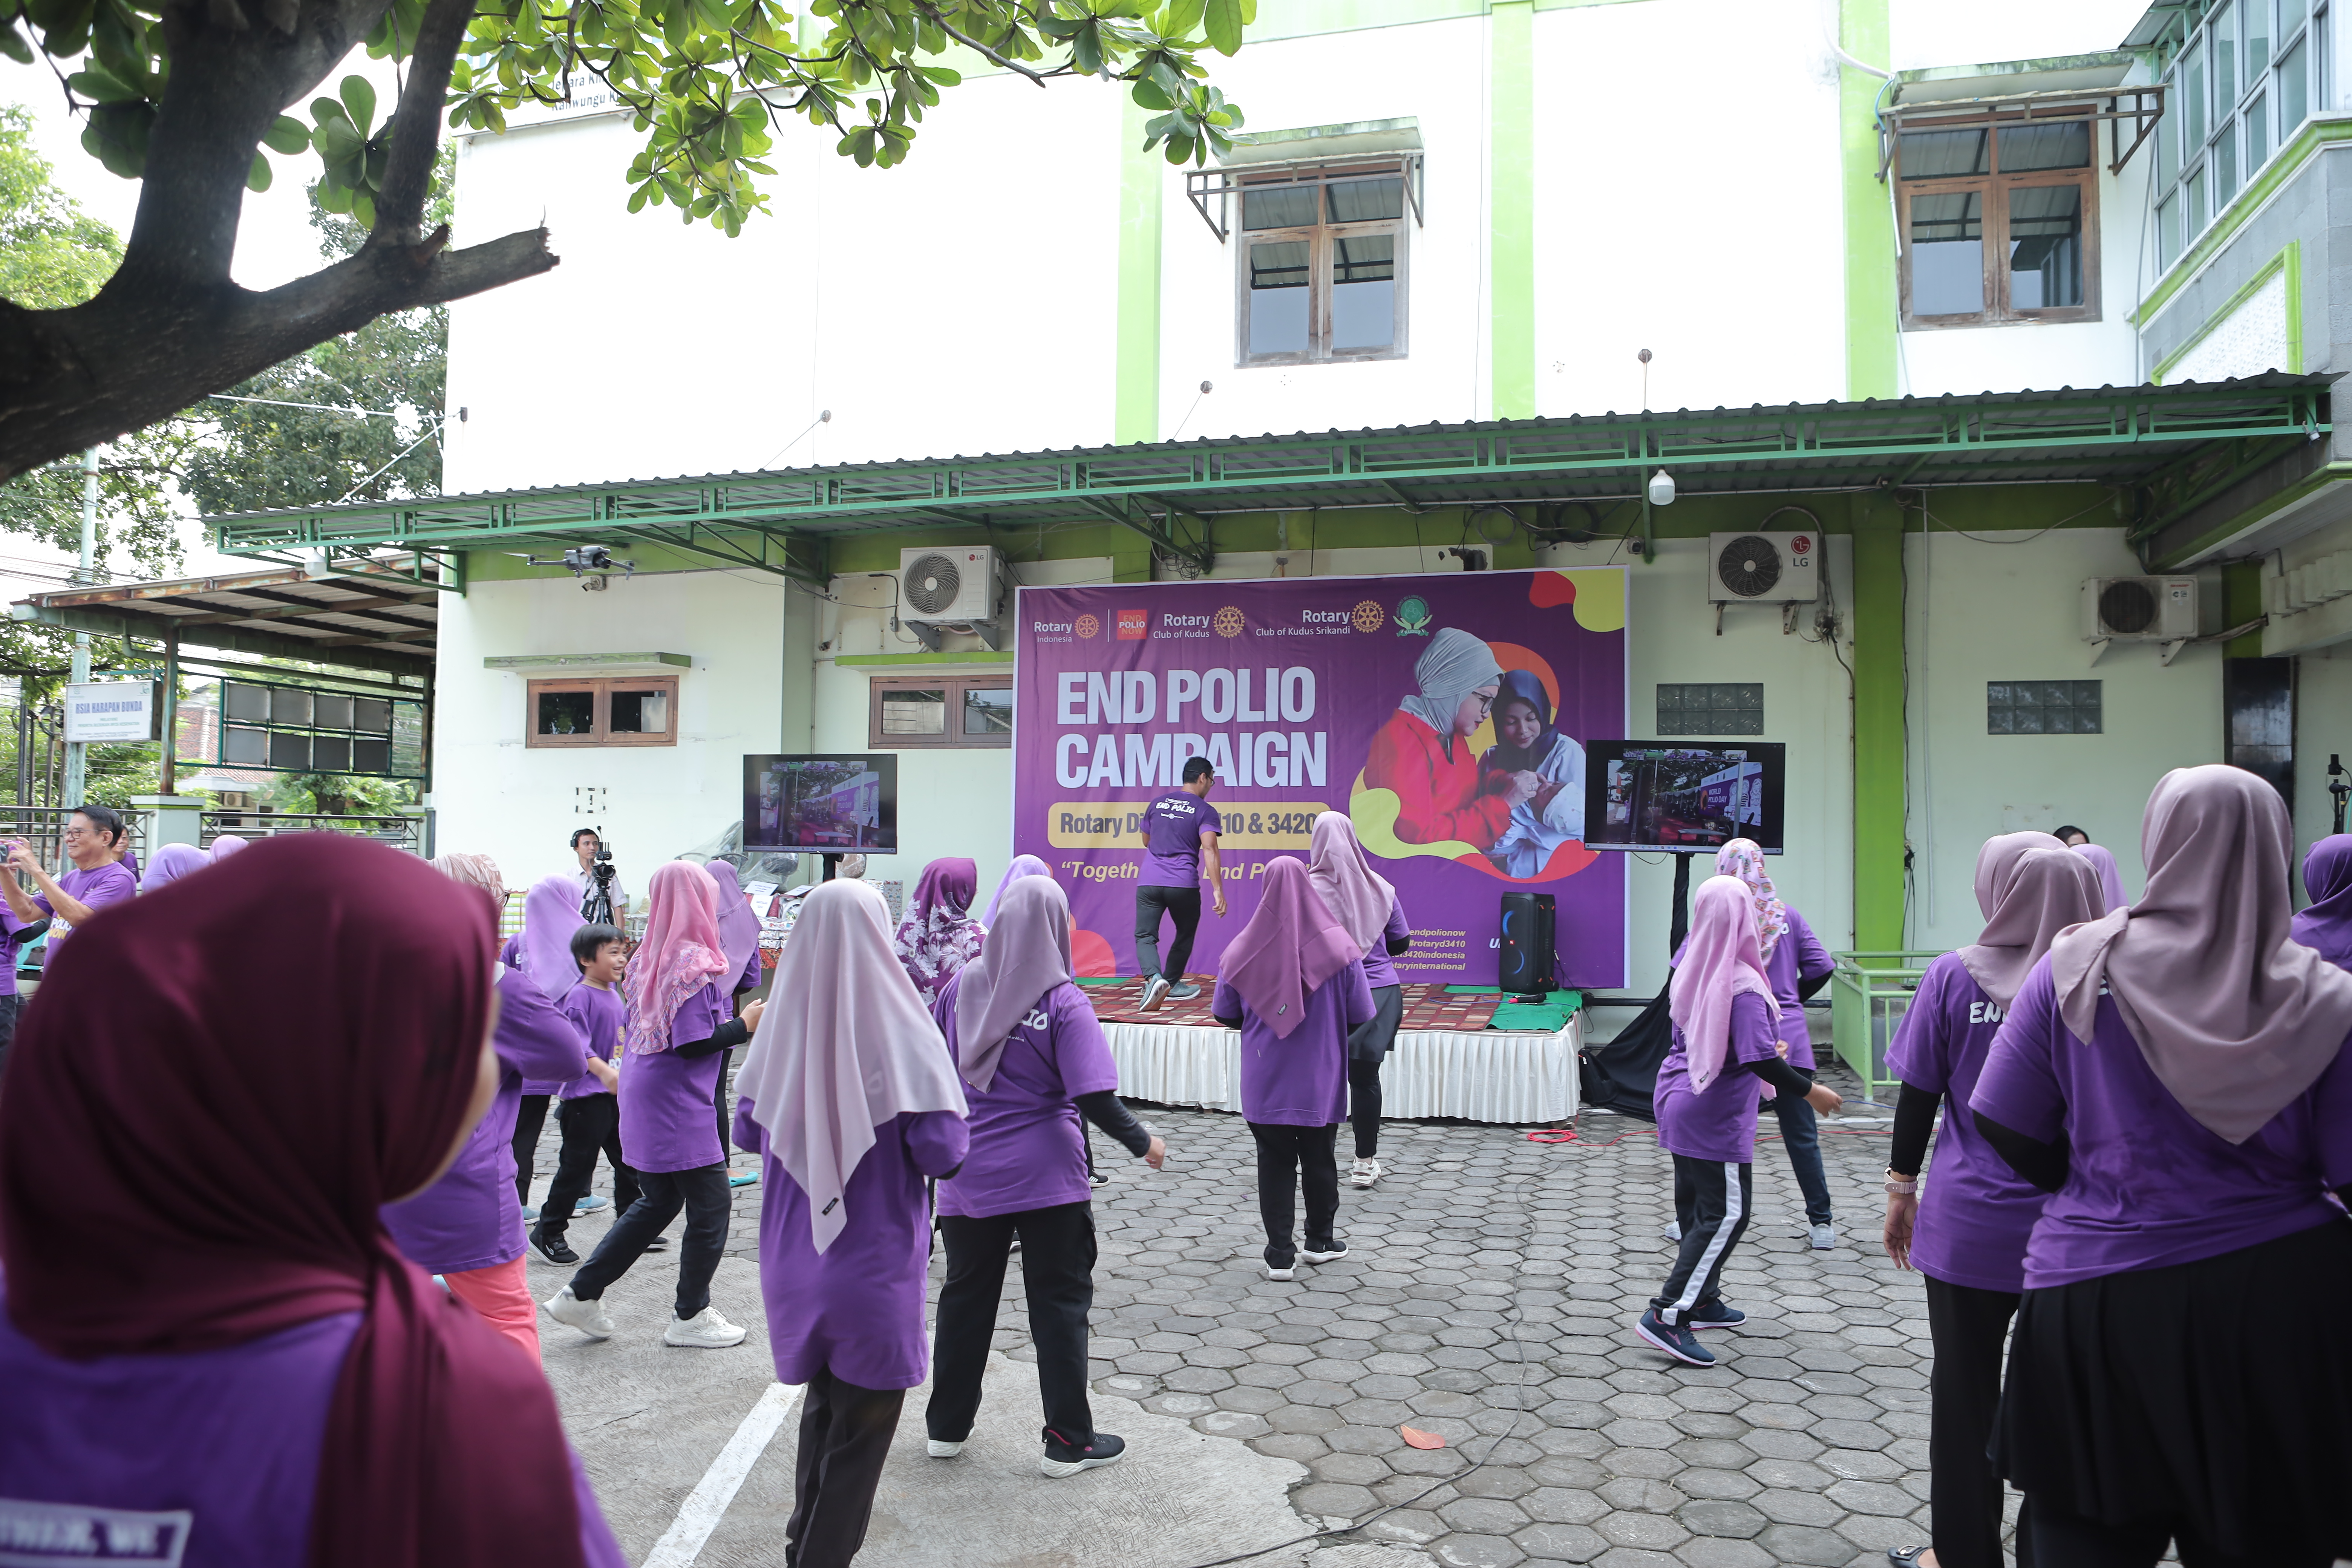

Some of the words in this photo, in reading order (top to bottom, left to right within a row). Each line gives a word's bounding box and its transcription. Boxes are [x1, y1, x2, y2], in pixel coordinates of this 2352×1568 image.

[1793, 558, 1808, 567] LG
[1164, 613, 1210, 629] Rotary
[1302, 609, 1350, 625] Rotary
[1034, 622, 1073, 634] Rotary
[1153, 630, 1171, 639] Club
[1174, 629, 1183, 639] of
[1185, 629, 1210, 638] Kudus
[1256, 628, 1275, 636] Club
[1277, 627, 1286, 635] of
[1288, 626, 1314, 635] Kudus
[1316, 626, 1351, 635] Srikandi
[1057, 671, 1157, 724] END
[1167, 666, 1316, 723] POLIO
[76, 703, 90, 714] RSIA
[92, 702, 120, 713] HARAPAN
[121, 701, 142, 712] BUNDA
[1056, 731, 1327, 788] CAMPAIGN
[1171, 804, 1195, 814] POLIO
[1061, 813, 1123, 838] Rotary
[1218, 813, 1244, 834] 10
[1248, 813, 1264, 834] &
[1268, 813, 1316, 834] 3420
[1061, 861, 1139, 882] “Togeth
[1410, 928, 1466, 937] endpolionow
[1409, 939, 1466, 949] #rotaryd3410
[1392, 962, 1466, 971] taryinternational
[1969, 1001, 2007, 1024] EN
